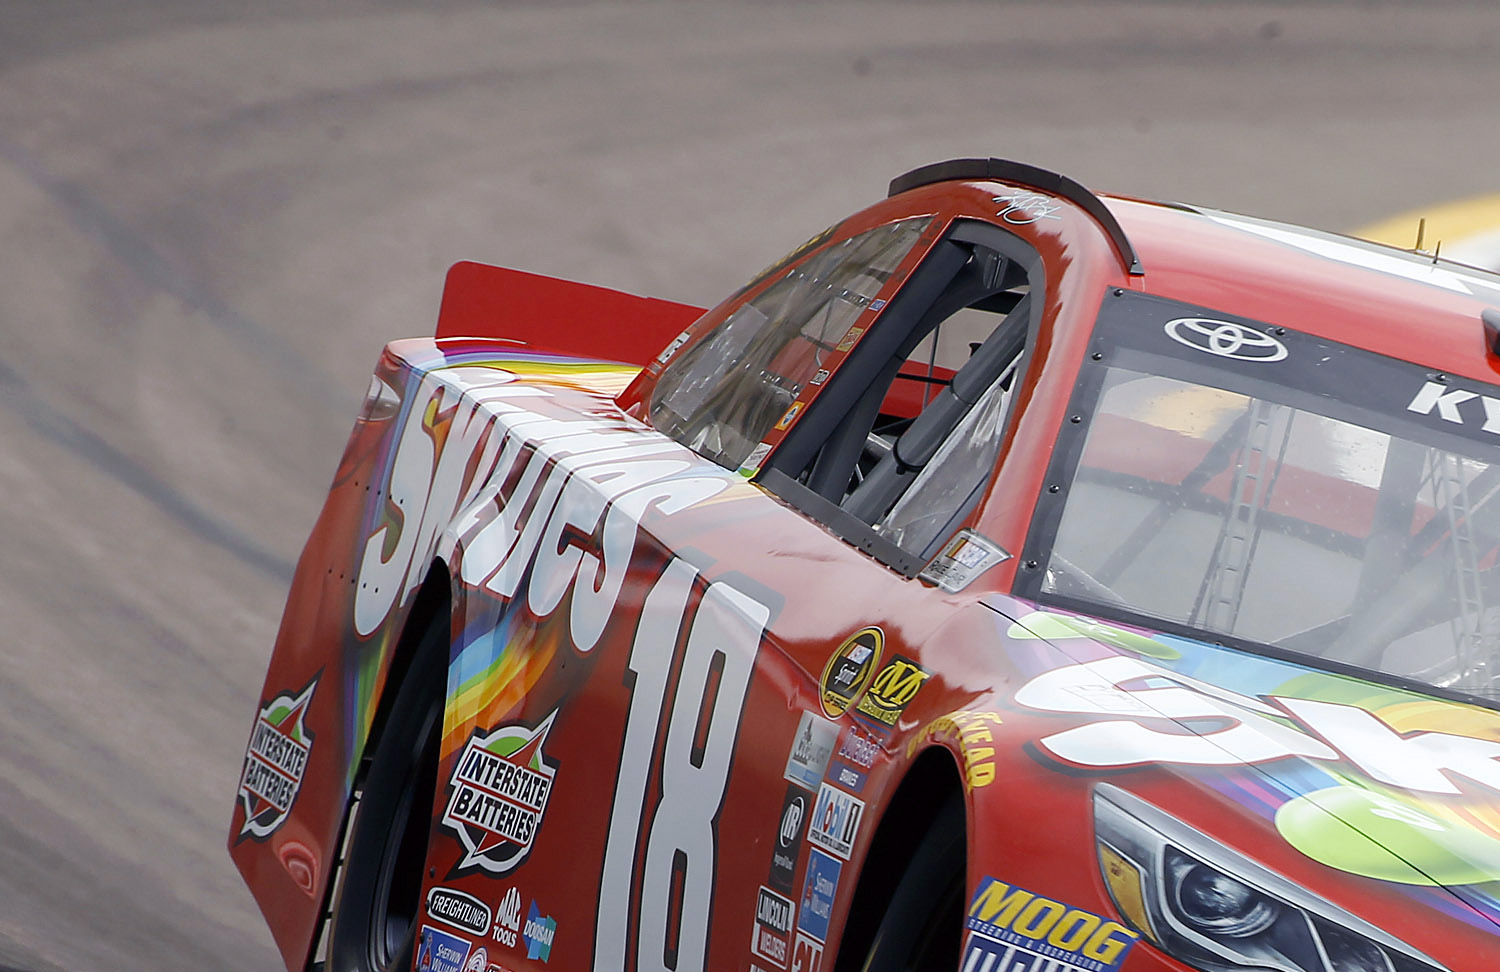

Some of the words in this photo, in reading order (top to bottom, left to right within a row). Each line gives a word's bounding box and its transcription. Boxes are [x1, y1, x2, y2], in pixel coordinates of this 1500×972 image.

[252, 722, 308, 780] INTERSTATE
[246, 757, 294, 810] BATTERIES
[461, 750, 549, 810] INTERSTATE
[454, 787, 535, 840] BATTERIES
[782, 803, 800, 841] IR
[812, 787, 850, 840] Mobil
[431, 894, 487, 929] FREIGHTLINER
[495, 886, 522, 932] MAC
[523, 919, 555, 947] DOOSAN
[757, 893, 789, 932] LINCOLN
[968, 880, 1140, 966] MOOG
[492, 925, 518, 949] TOOLS
[968, 918, 1022, 945] STEERING
[1037, 943, 1103, 972] SUSPENSION
